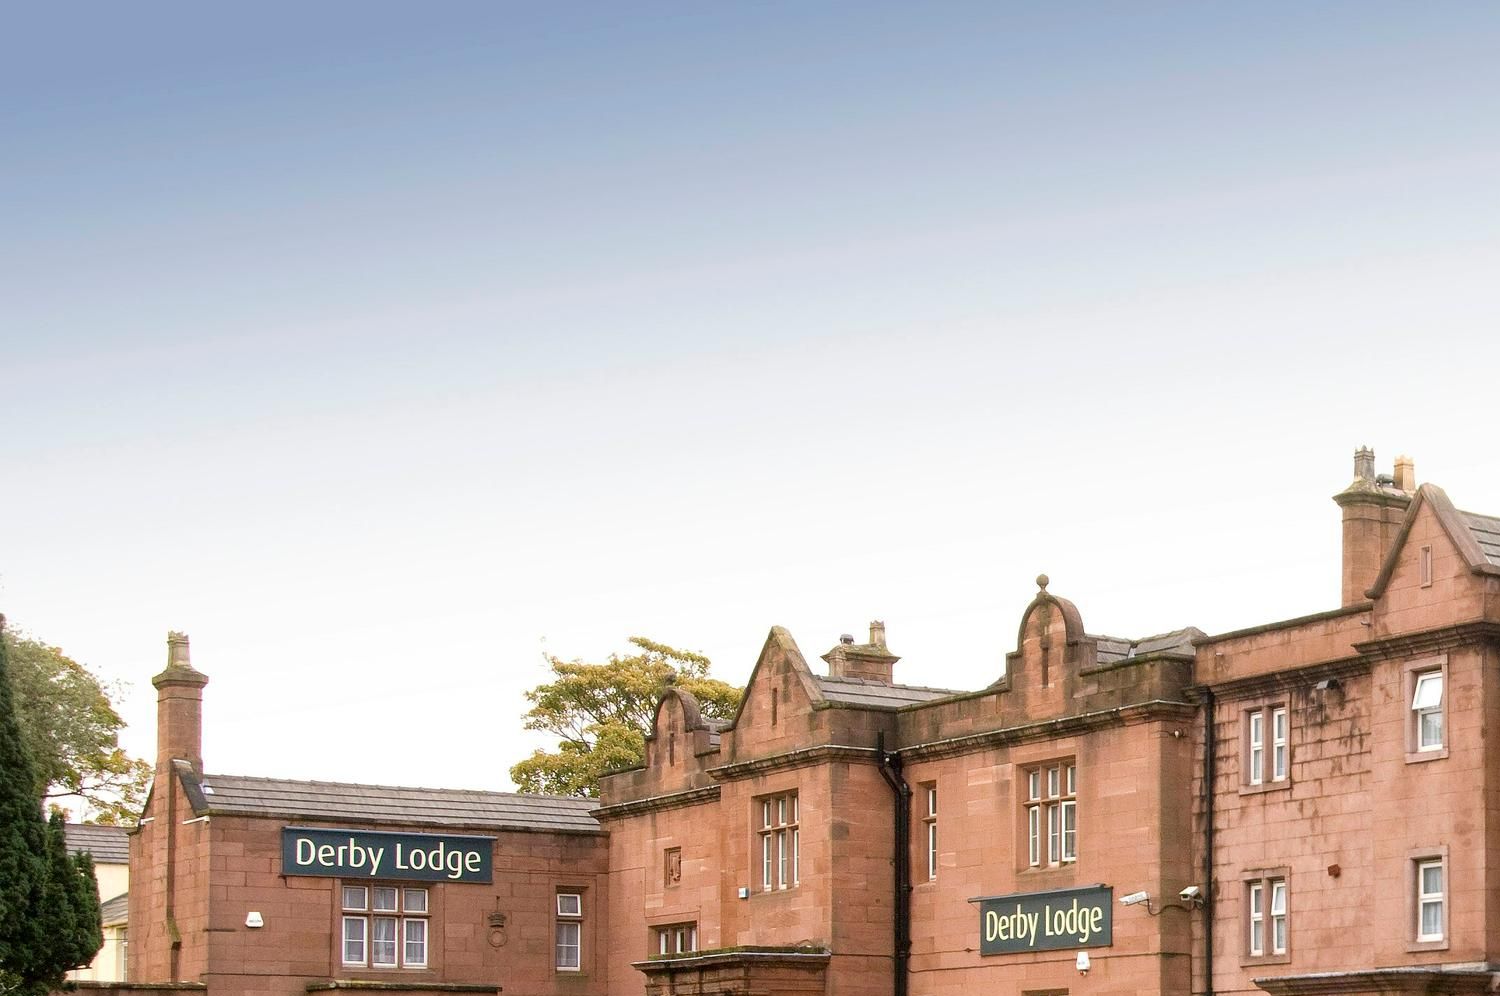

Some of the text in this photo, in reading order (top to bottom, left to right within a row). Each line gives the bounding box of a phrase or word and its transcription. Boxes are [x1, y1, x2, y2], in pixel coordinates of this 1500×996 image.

[296, 837, 481, 879] Derby Lodge
[985, 898, 1103, 947] Derby Lodge
